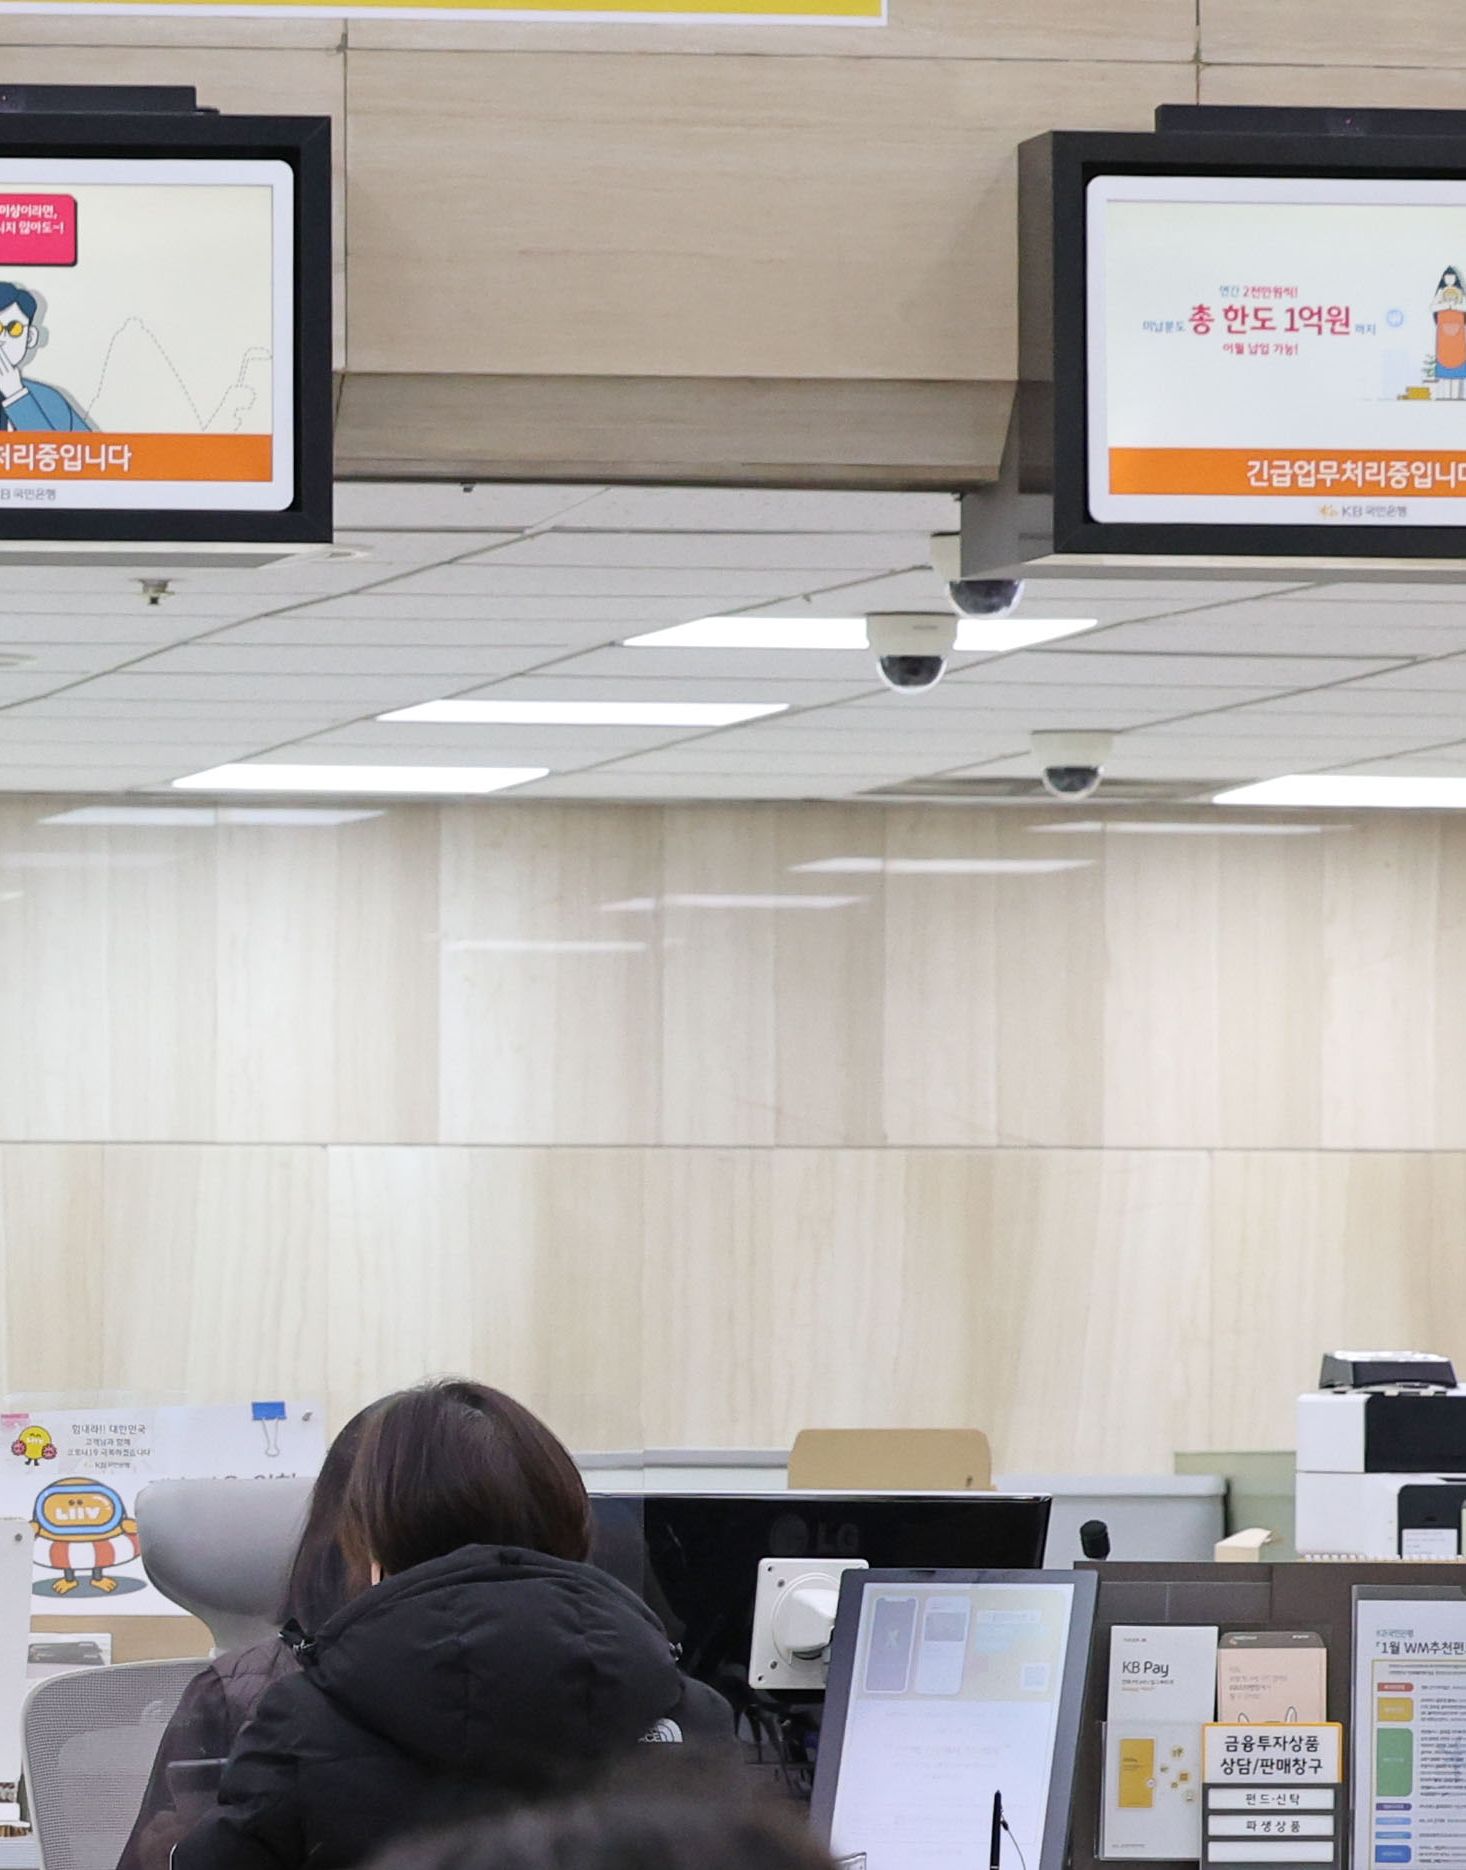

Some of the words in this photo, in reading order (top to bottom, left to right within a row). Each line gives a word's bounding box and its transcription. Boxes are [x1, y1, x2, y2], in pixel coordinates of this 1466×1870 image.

[1188, 303, 1215, 336] 총
[1221, 304, 1277, 335] 한도
[1284, 305, 1351, 336] 1억원
[12, 486, 57, 501] 국민은행
[1342, 505, 1363, 517] KB
[71, 1424, 106, 1435] 힘내라!!
[109, 1424, 147, 1435] 대한민국
[1121, 1660, 1141, 1674] KB
[1143, 1660, 1169, 1677] Pay
[1224, 1735, 1321, 1753] 금융투자상품
[1220, 1758, 1324, 1776] 상담/판매창구
